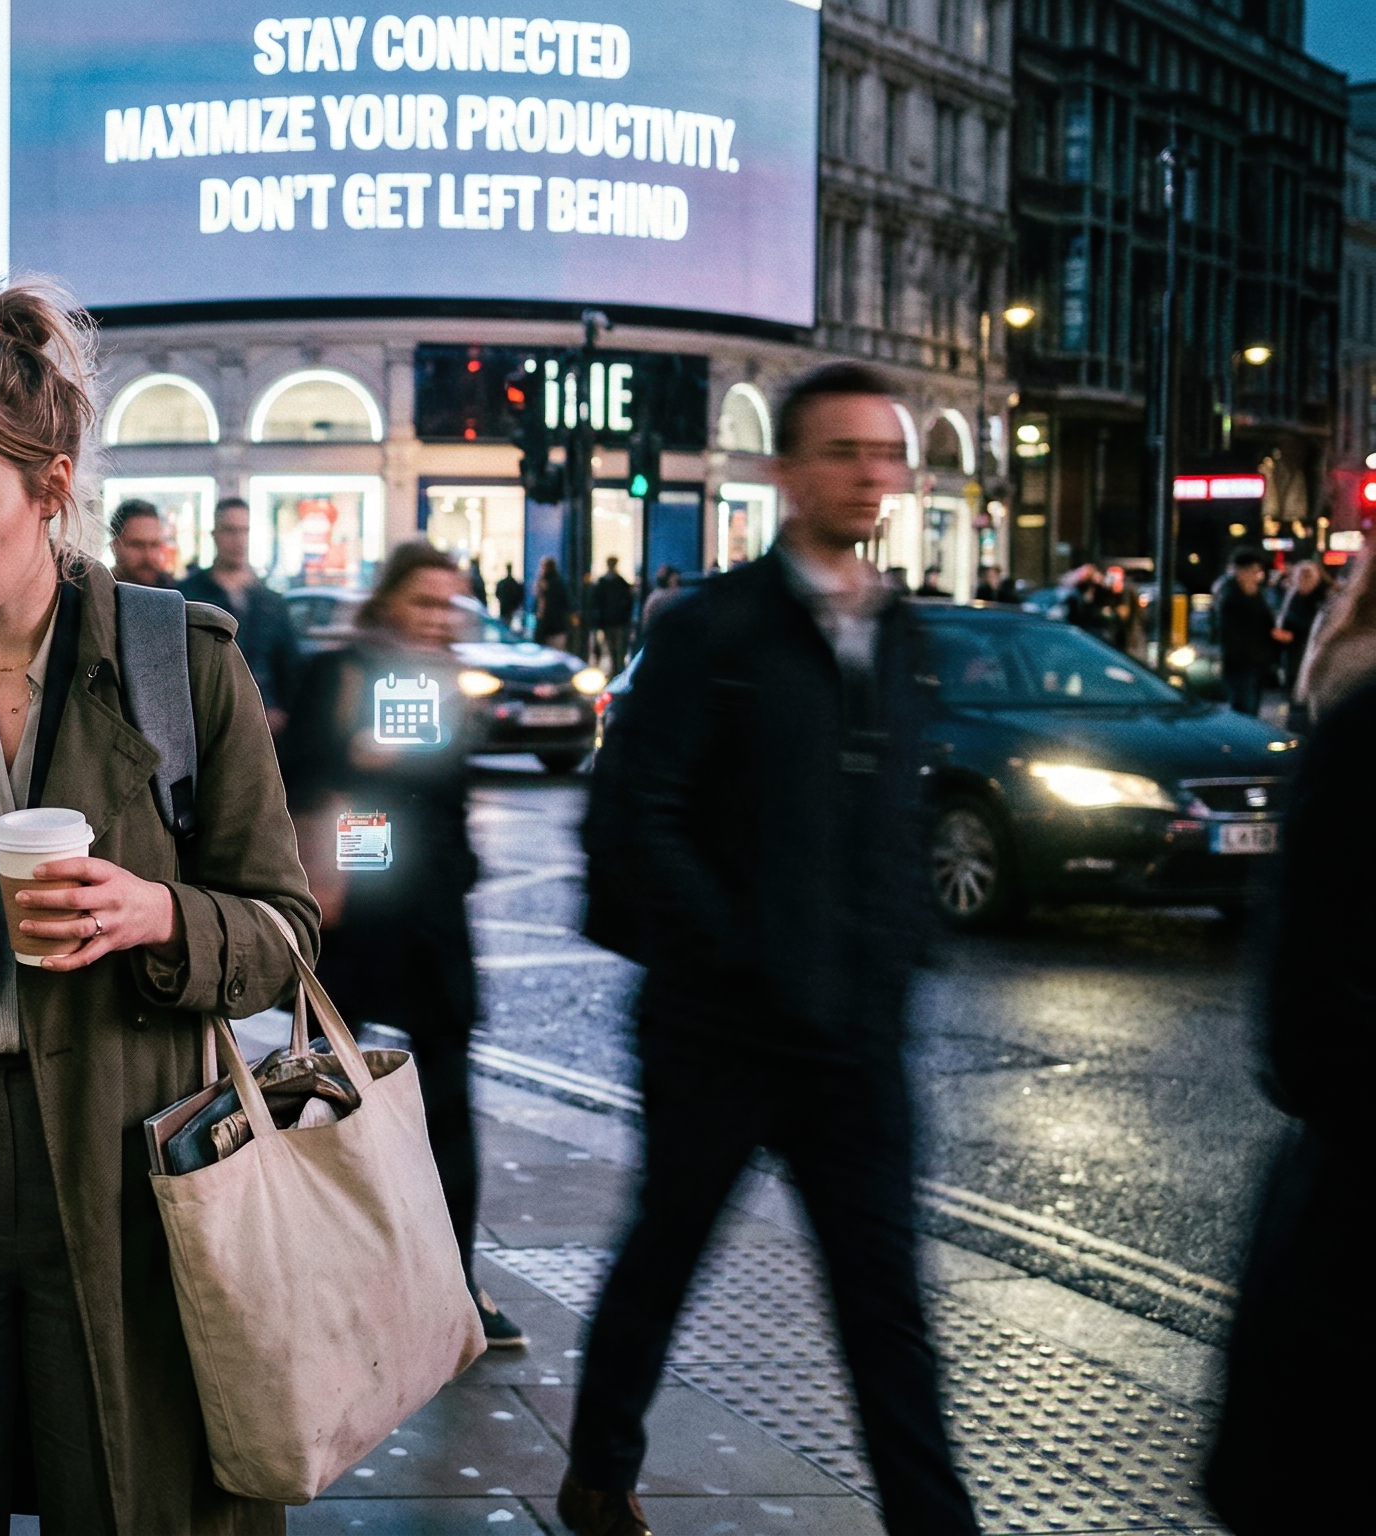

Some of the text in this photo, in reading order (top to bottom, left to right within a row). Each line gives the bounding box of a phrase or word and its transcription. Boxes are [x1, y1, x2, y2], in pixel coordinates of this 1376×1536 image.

[253, 15, 630, 79] STAY CONNECTED
[105, 94, 740, 173] MAXIMIZE YOUR PRODUCTIVITY.
[200, 173, 689, 241] DON'T GET LEFT BEHIND
